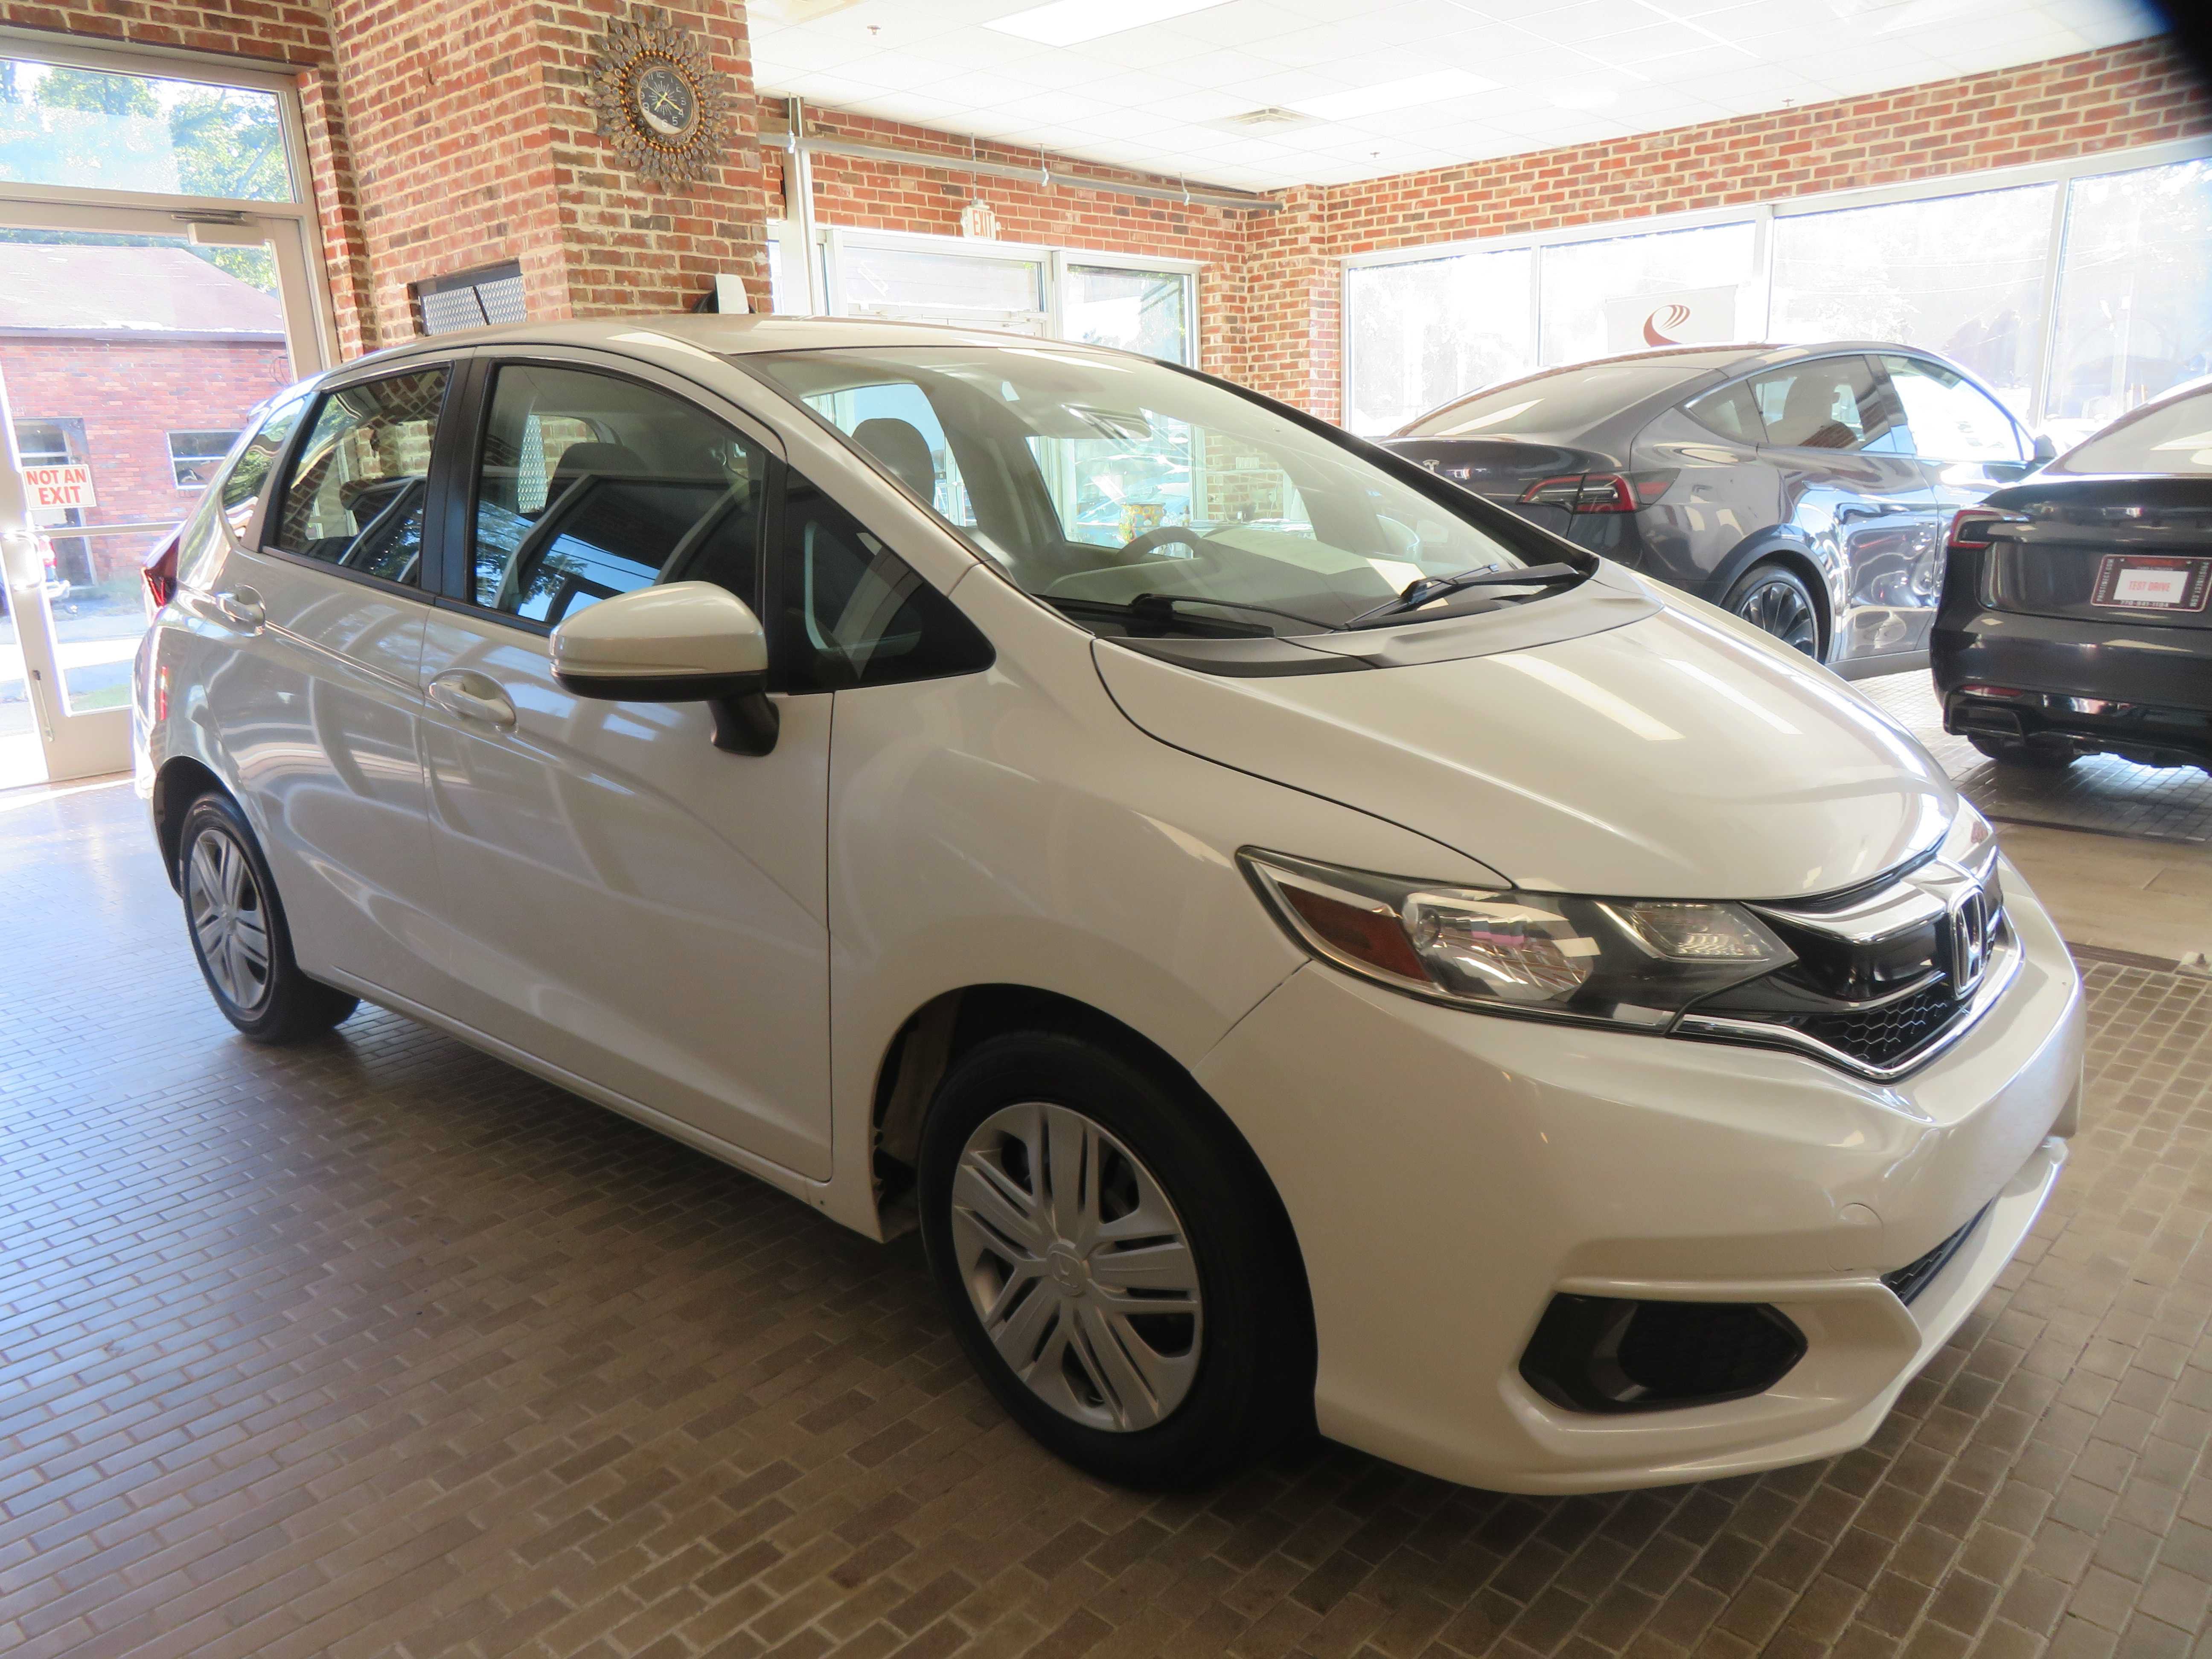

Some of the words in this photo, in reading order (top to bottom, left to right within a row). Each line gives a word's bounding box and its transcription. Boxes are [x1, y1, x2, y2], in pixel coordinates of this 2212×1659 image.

[662, 119, 668, 128] 6
[672, 116, 678, 125] 5
[972, 210, 992, 239] EXIT
[26, 470, 59, 486] NOT
[64, 469, 87, 483] AN
[38, 486, 81, 505] EXIT
[2128, 581, 2146, 591] TEST
[2148, 582, 2171, 591] DRIVE
